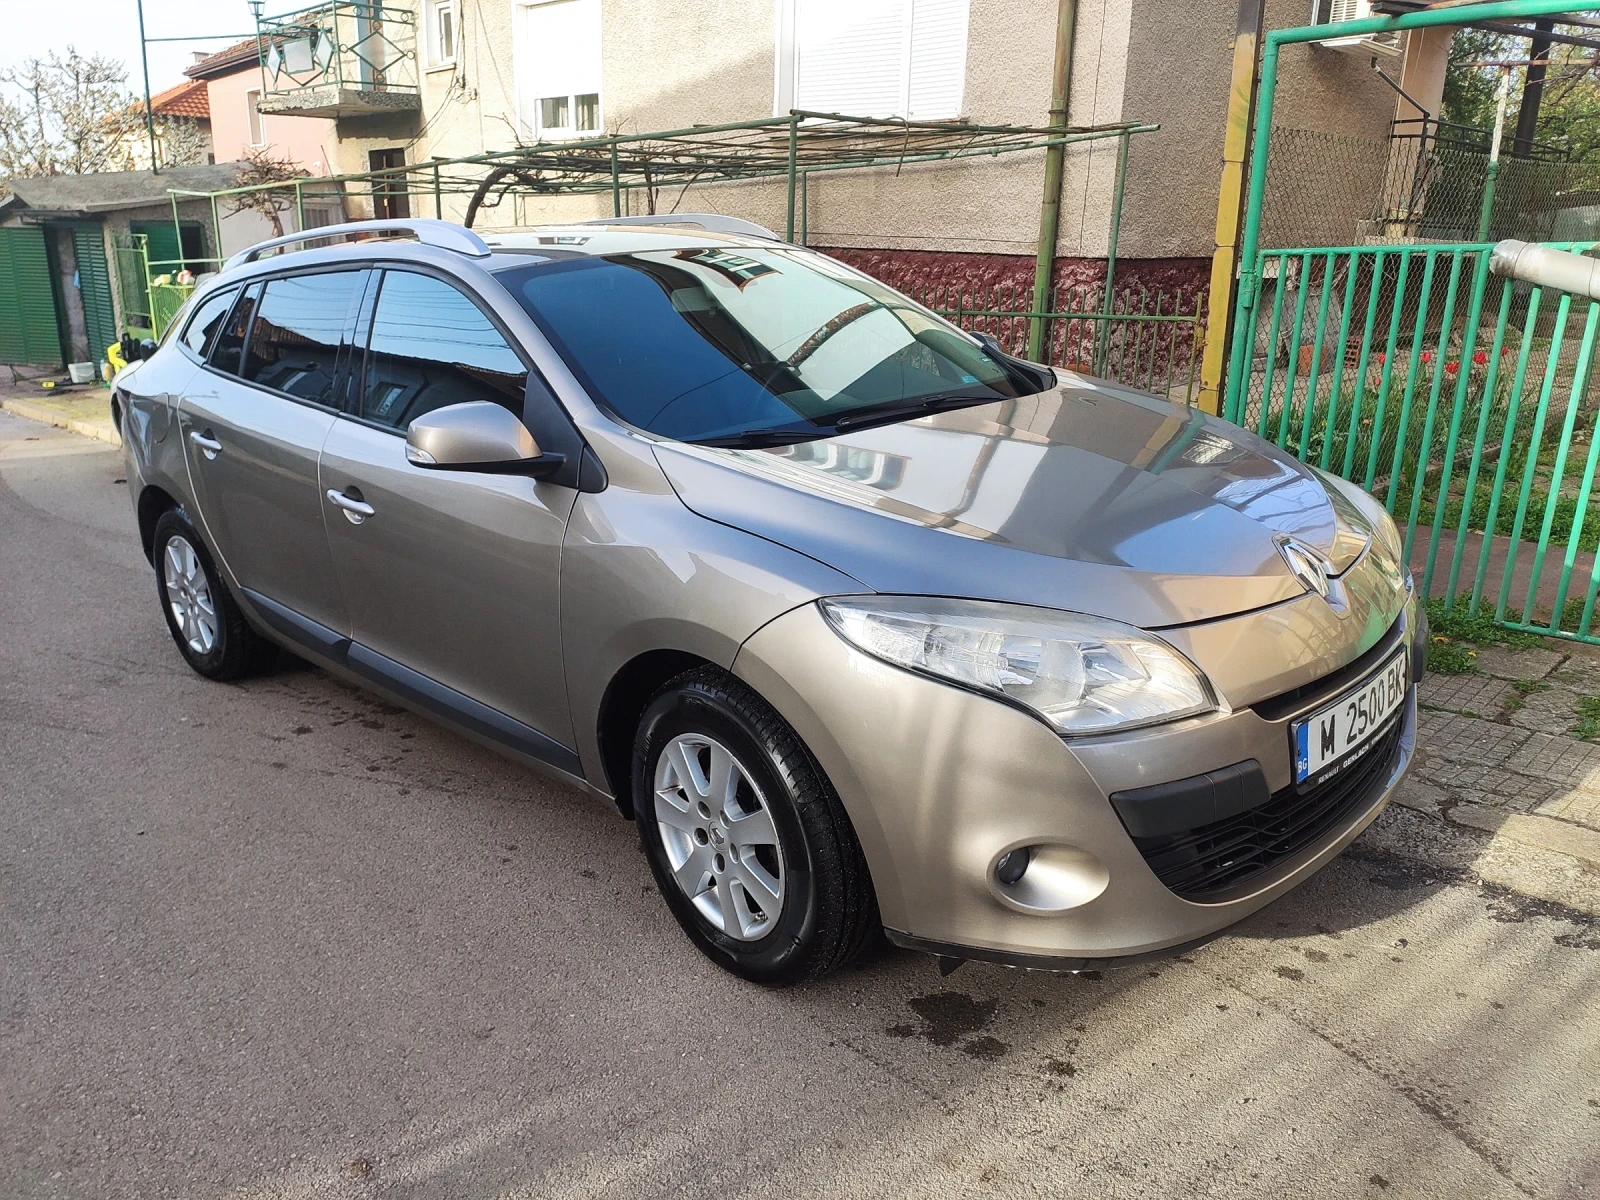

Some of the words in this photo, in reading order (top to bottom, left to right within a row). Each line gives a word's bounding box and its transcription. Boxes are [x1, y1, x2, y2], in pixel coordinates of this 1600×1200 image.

[1320, 714, 1336, 761] M
[1346, 678, 1385, 745] 2500
[1387, 657, 1404, 709] BK
[1297, 758, 1308, 773] BG
[1318, 766, 1340, 784] RENAULT
